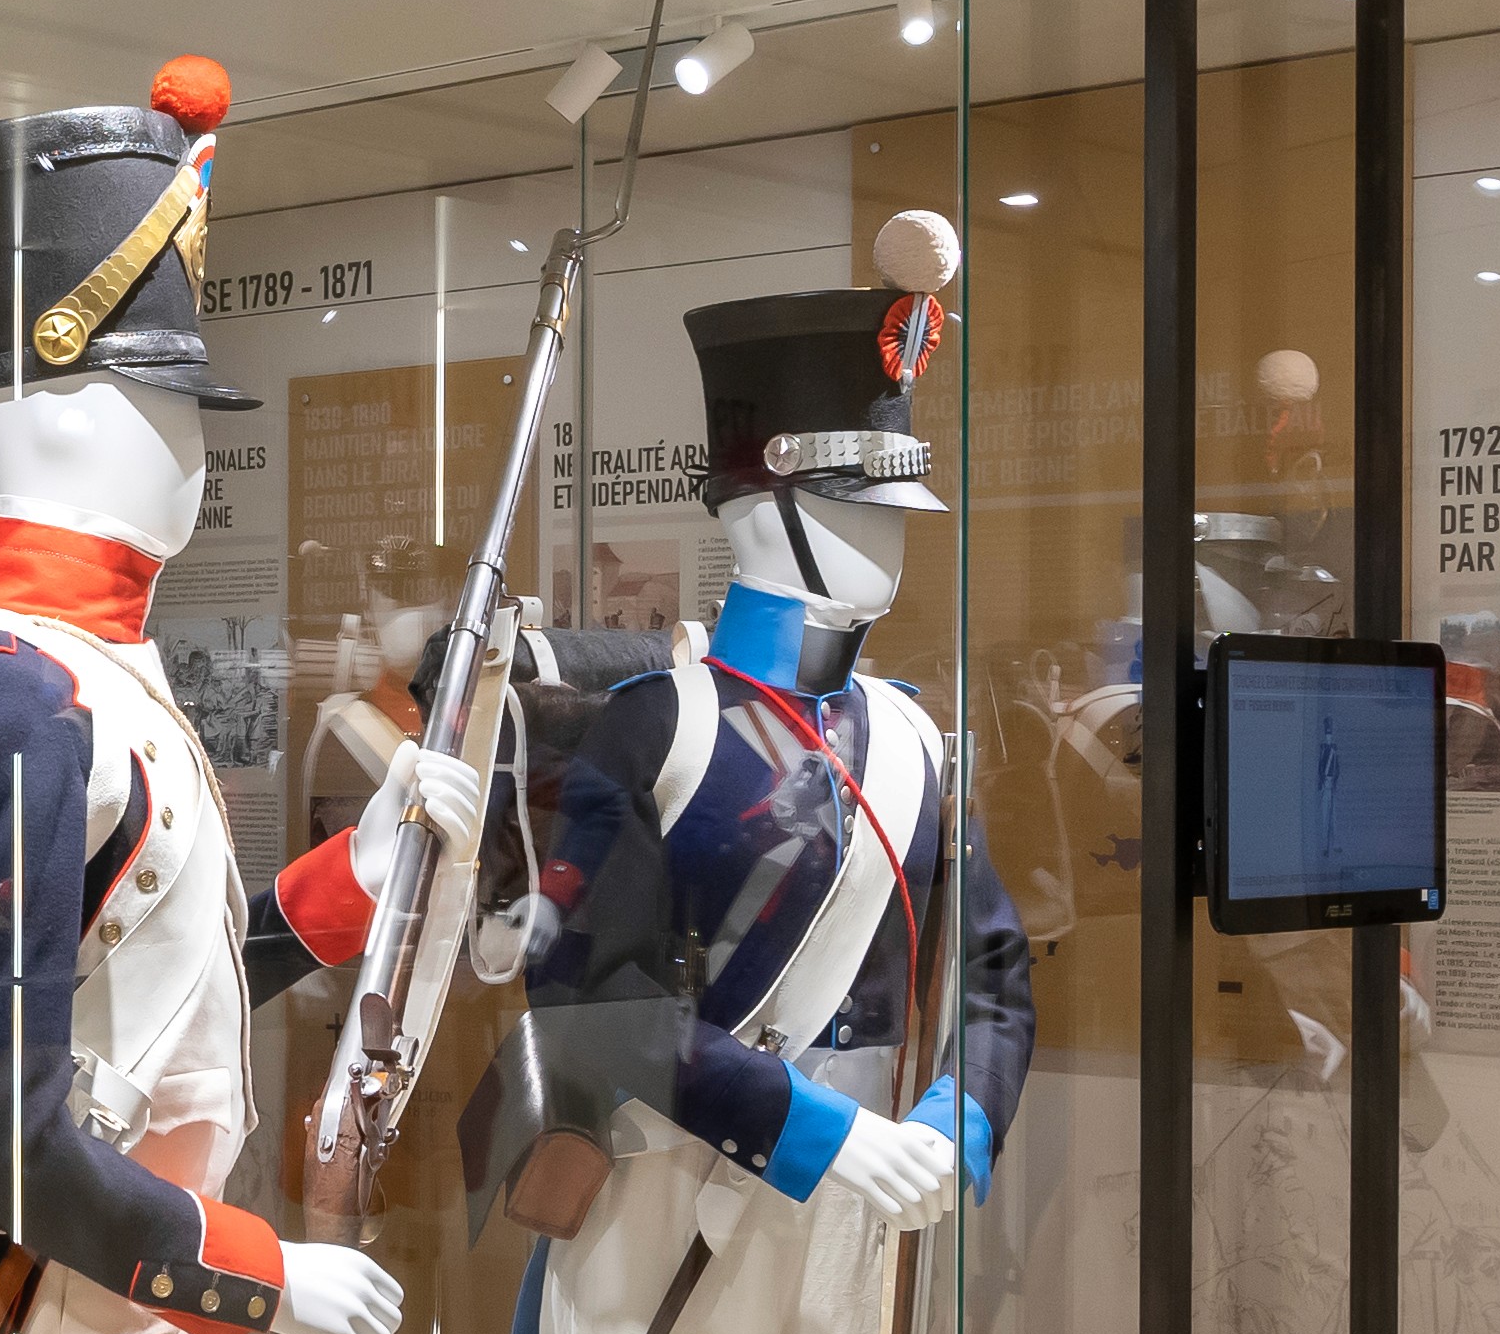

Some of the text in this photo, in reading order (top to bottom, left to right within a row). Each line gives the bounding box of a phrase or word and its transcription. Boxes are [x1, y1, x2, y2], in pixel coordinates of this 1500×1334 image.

[237, 270, 294, 310] 1789
[319, 259, 373, 300] 1871
[303, 423, 486, 460] MAINTIEN DE L'ODRE
[205, 446, 266, 473] ONALES
[553, 439, 709, 479] NETRALITÉ ARM
[303, 462, 348, 490] DANS
[352, 462, 373, 486] LE
[1440, 464, 1484, 497] FIN
[384, 486, 452, 514] GUERE
[457, 484, 481, 510] DU
[194, 505, 233, 530] ENNE
[1440, 503, 1475, 535] DE
[1439, 540, 1496, 574] PAR
